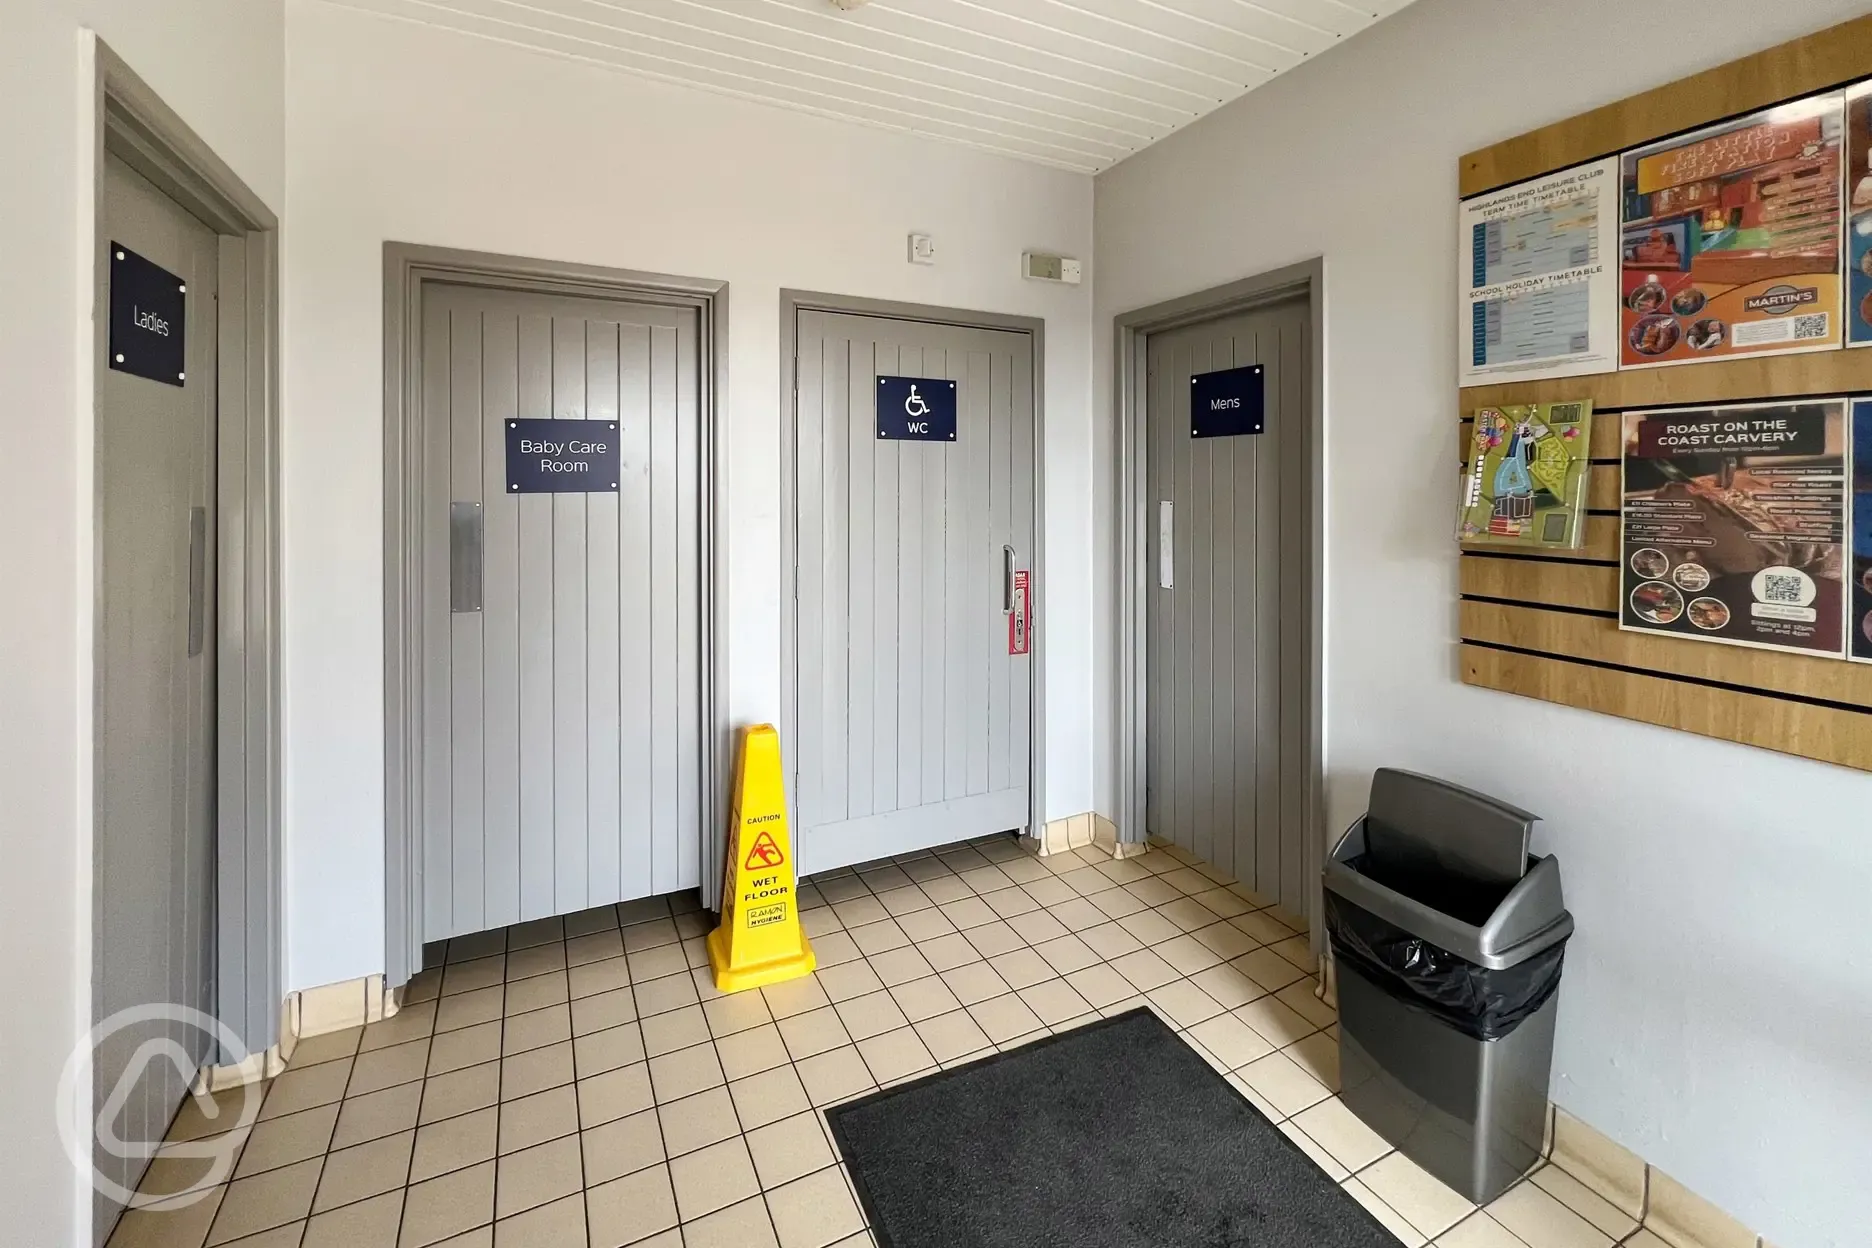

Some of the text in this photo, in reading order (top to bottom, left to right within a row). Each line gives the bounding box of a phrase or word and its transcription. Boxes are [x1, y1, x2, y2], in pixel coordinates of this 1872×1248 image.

[1468, 169, 1604, 213] HIGHLANDS END LEISURE CLUB
[1482, 184, 1585, 217] TERM TIME TIMETABLE
[1469, 266, 1603, 299] SCHOOL HOLIDAY TIMETABLE
[1749, 291, 1813, 308] MARTIN'S
[134, 304, 169, 337] Ladies
[1210, 397, 1241, 411] Mens
[907, 421, 929, 434] WC
[1667, 420, 1787, 434] ROAST ON THE
[1658, 431, 1799, 446] COAST CARVERY
[520, 439, 607, 456] Baby Care
[540, 459, 588, 472] Room
[747, 813, 781, 825] CAUTION
[752, 876, 778, 888] WET
[744, 887, 788, 902] FLOOR
[751, 914, 783, 926] HYGIENE
